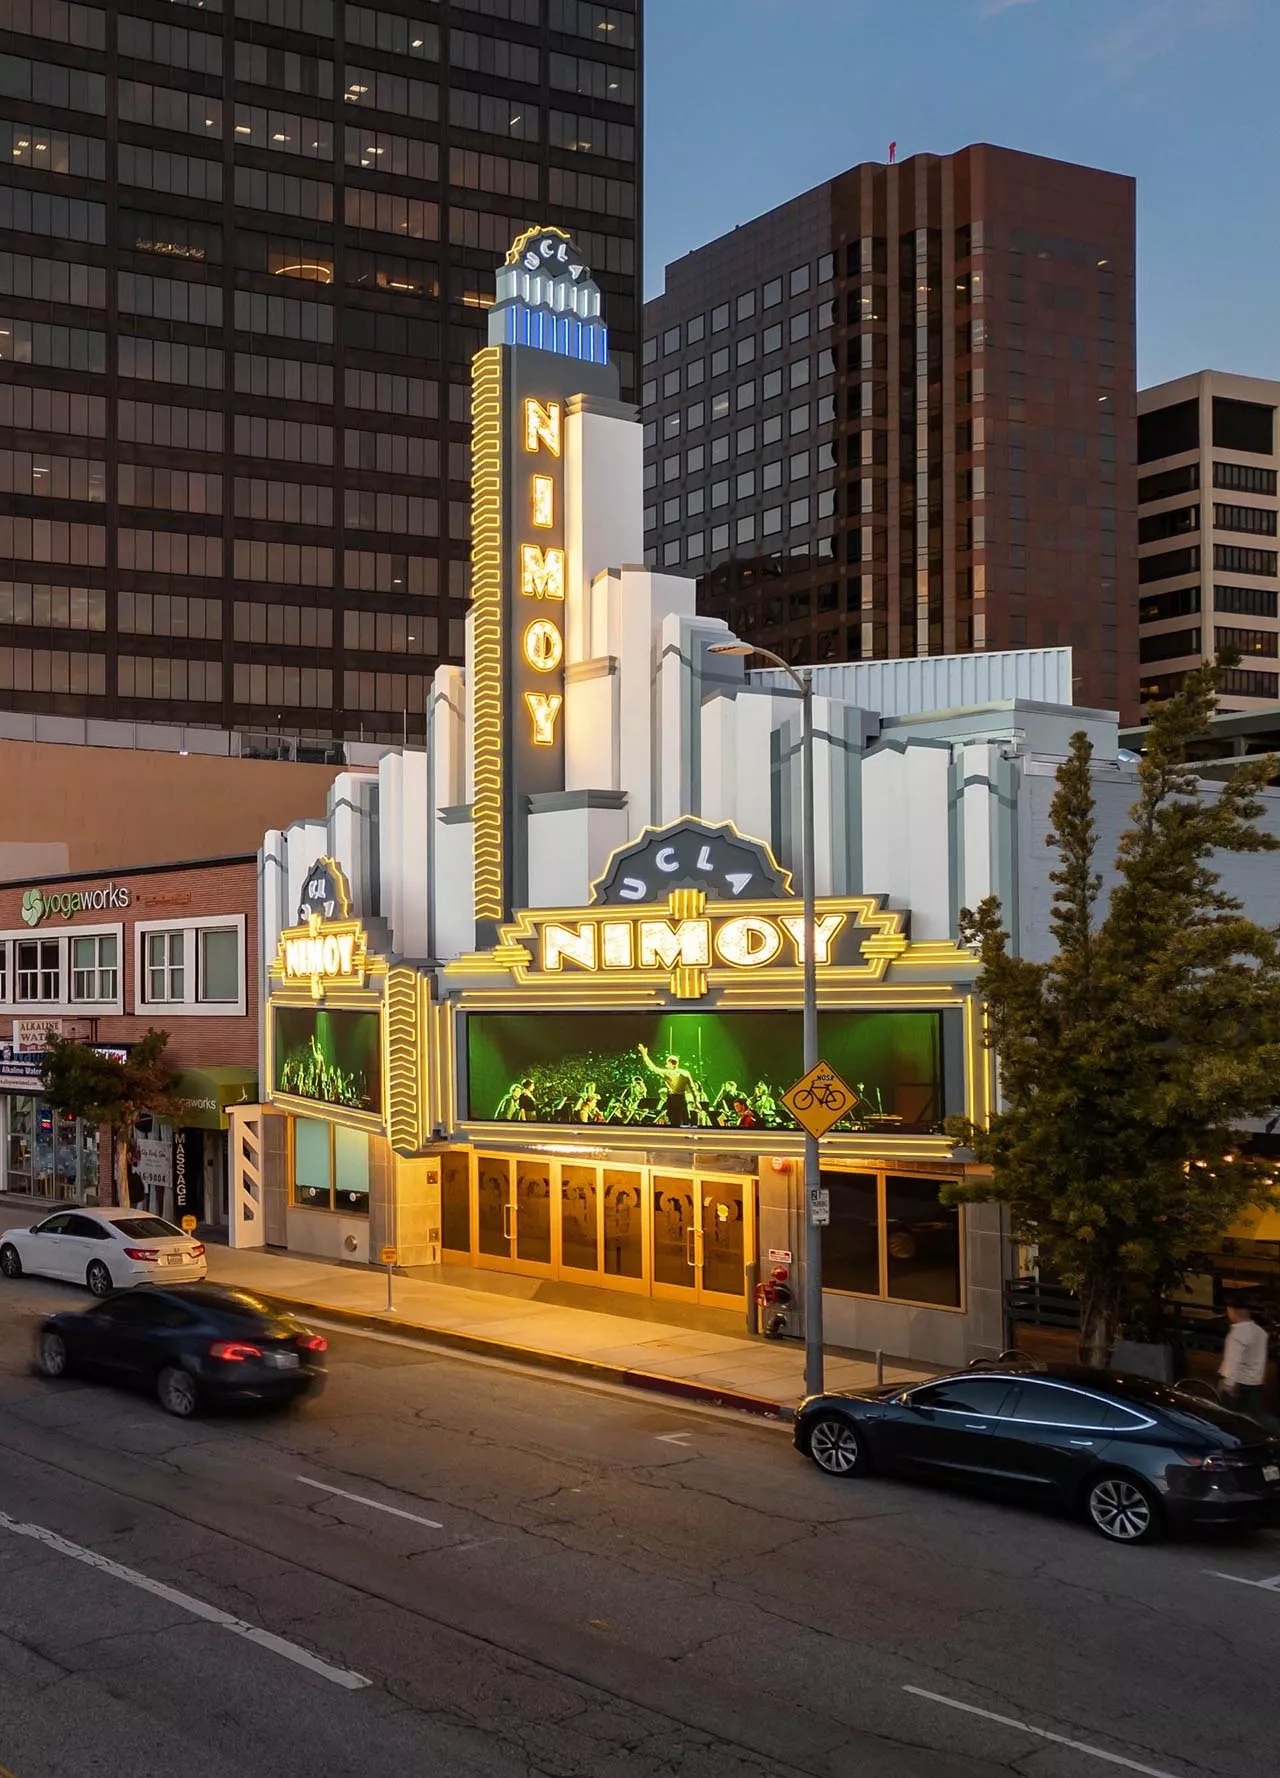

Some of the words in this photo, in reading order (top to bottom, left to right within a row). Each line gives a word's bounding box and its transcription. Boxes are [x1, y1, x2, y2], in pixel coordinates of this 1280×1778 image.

[524, 239, 584, 280] UCLA
[521, 397, 565, 745] NIMOY
[620, 846, 753, 900] UCLA
[43, 882, 129, 919] yogaworks
[285, 933, 355, 978] NIMOY
[542, 913, 849, 972] NIMOY
[20, 1021, 59, 1032] ALKALINE
[1, 1065, 24, 1075] Alkaline
[24, 1066, 43, 1076] Water
[175, 1133, 187, 1206] MASSAGE
